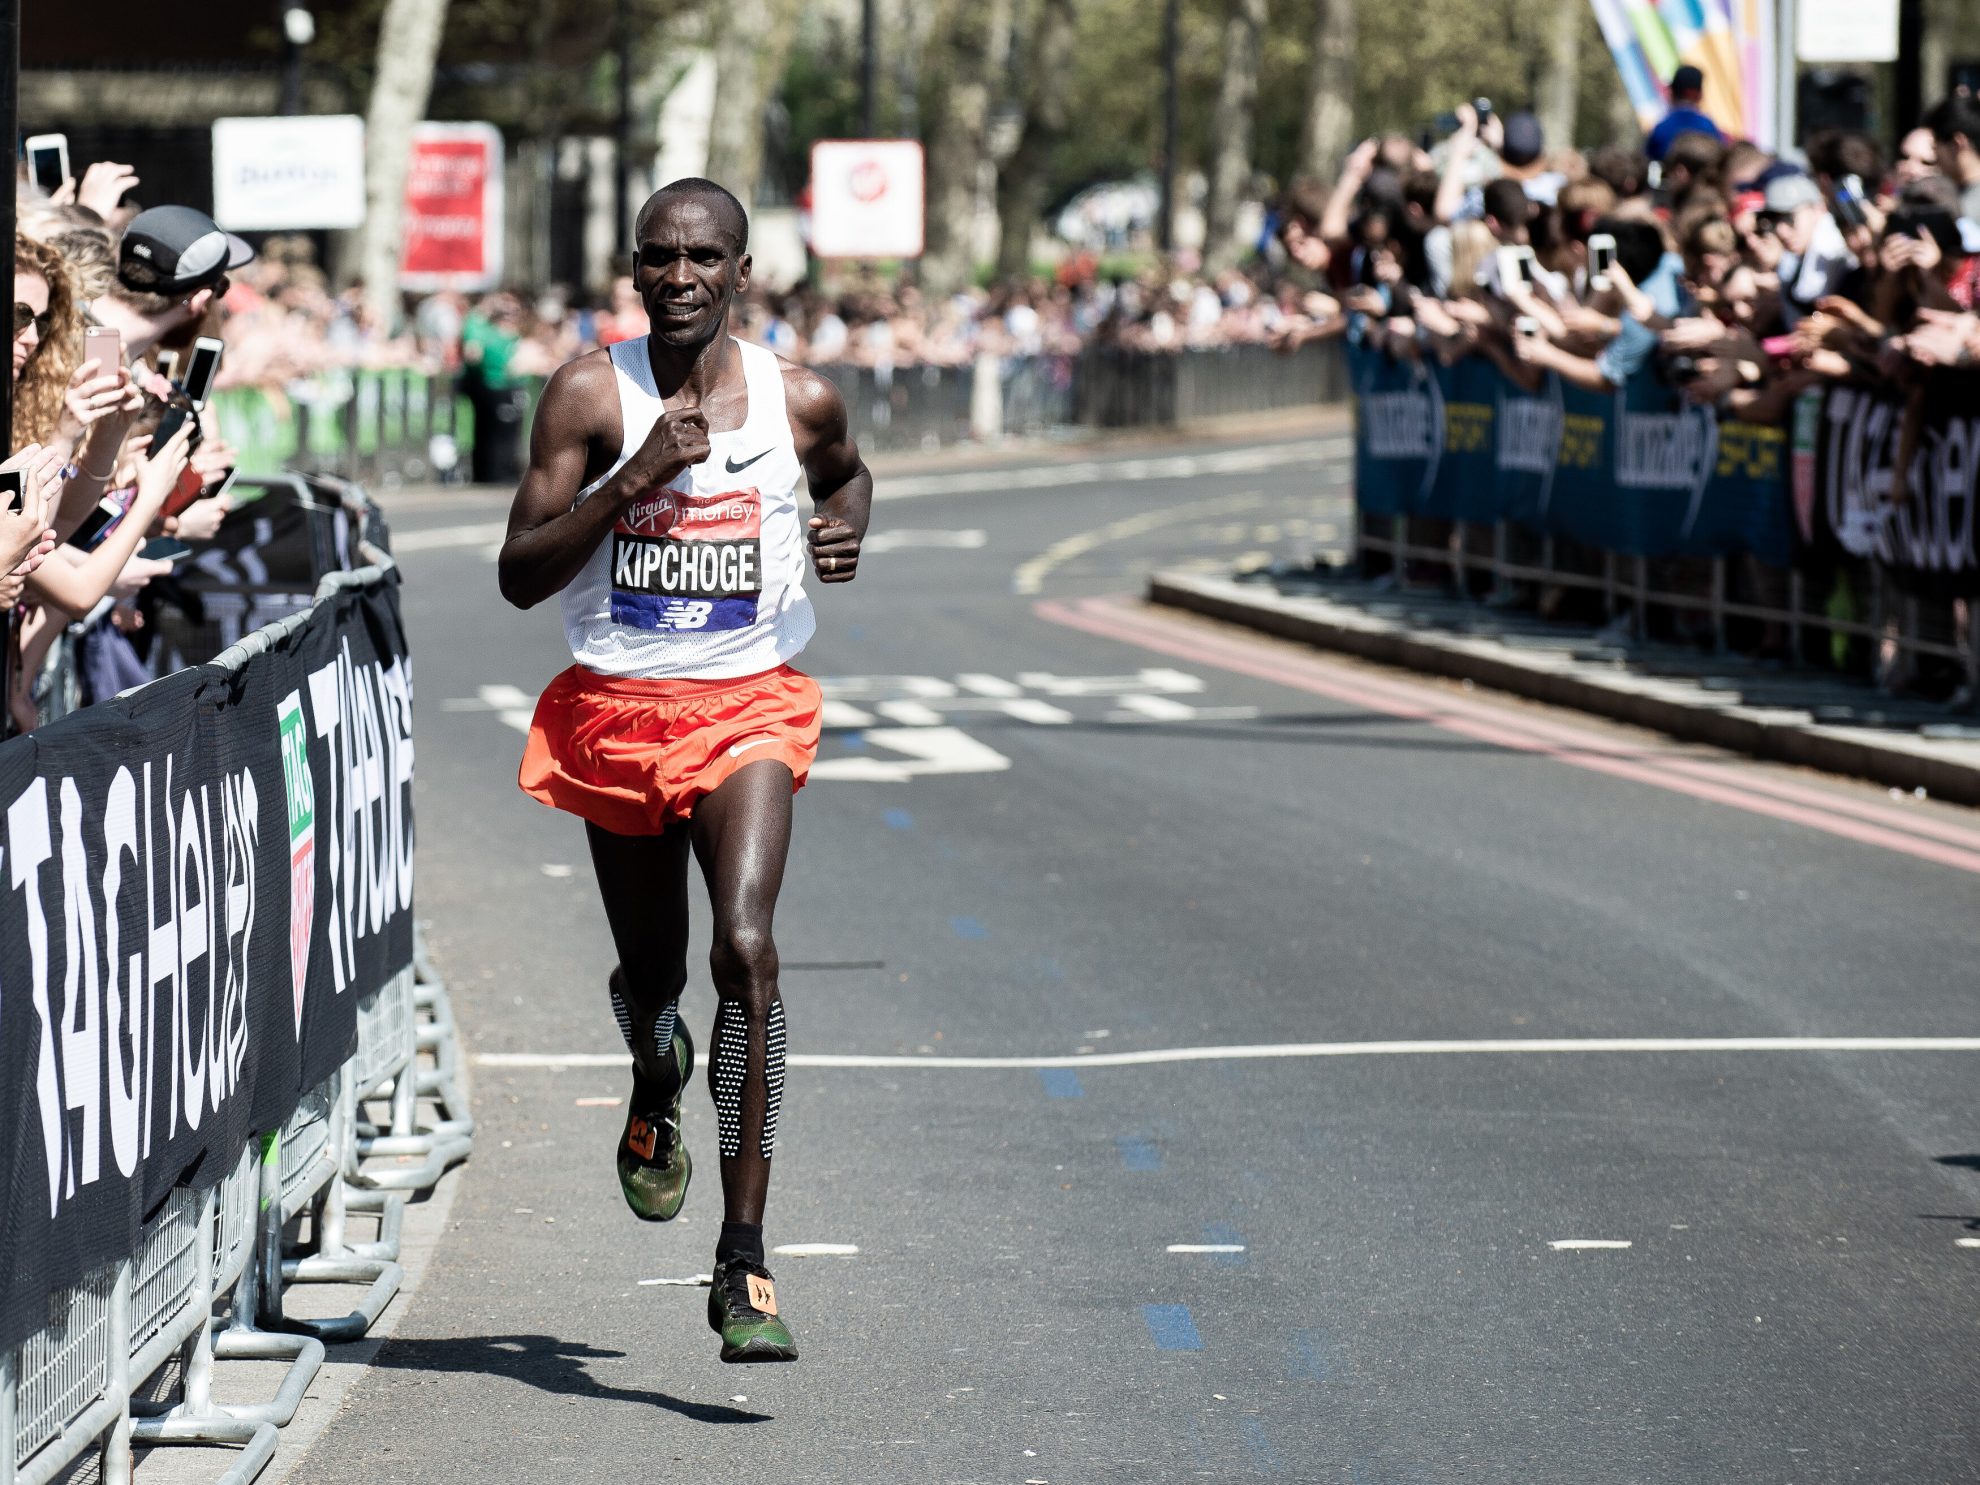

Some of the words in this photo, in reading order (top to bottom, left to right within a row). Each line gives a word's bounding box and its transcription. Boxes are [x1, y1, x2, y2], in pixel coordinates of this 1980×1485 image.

[628, 495, 673, 532] Virgin
[682, 502, 754, 524] money
[615, 541, 755, 592] KIPCHOGE
[281, 727, 312, 827] TAG
